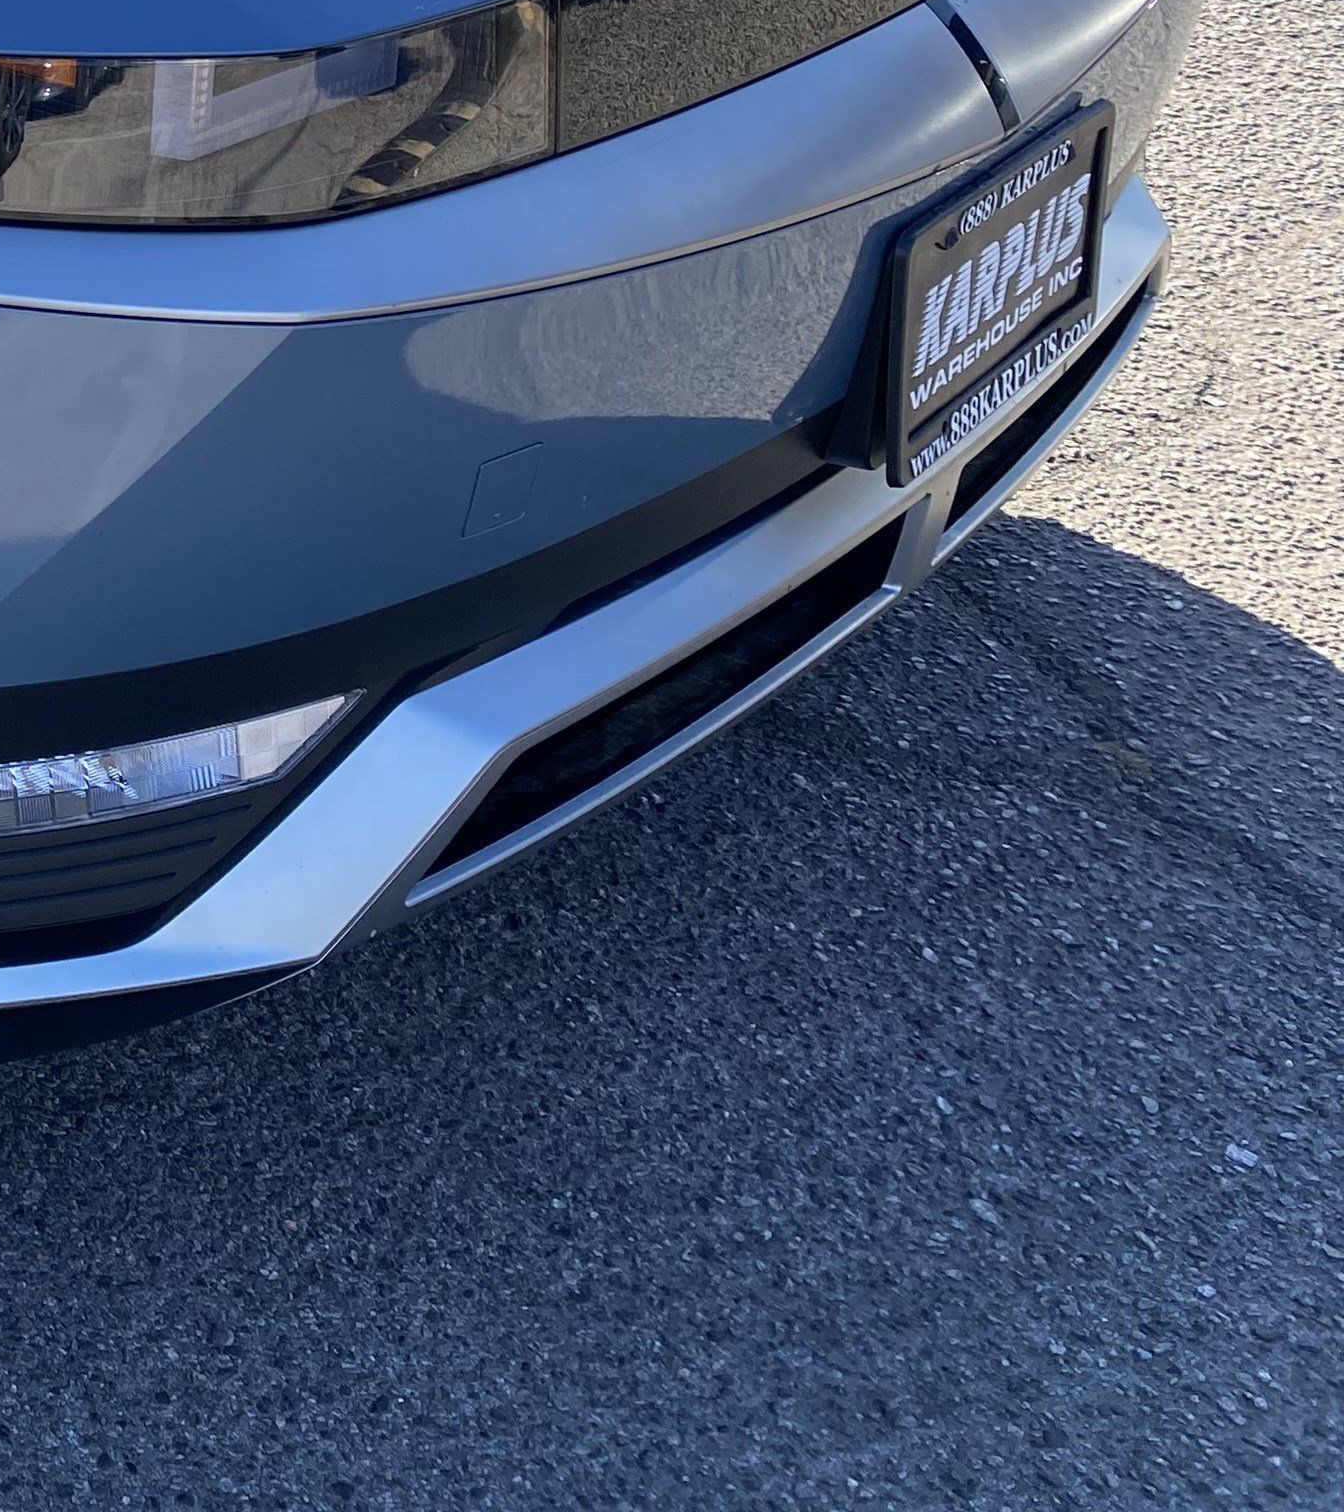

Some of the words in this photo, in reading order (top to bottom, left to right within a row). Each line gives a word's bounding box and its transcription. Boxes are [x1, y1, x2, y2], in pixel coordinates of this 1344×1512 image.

[960, 191, 998, 236] (888)
[1000, 139, 1072, 209] KARPLUS
[909, 286, 1043, 410] WAREHOUSE
[1048, 256, 1083, 296] INC
[912, 172, 1092, 377] KARPLUS
